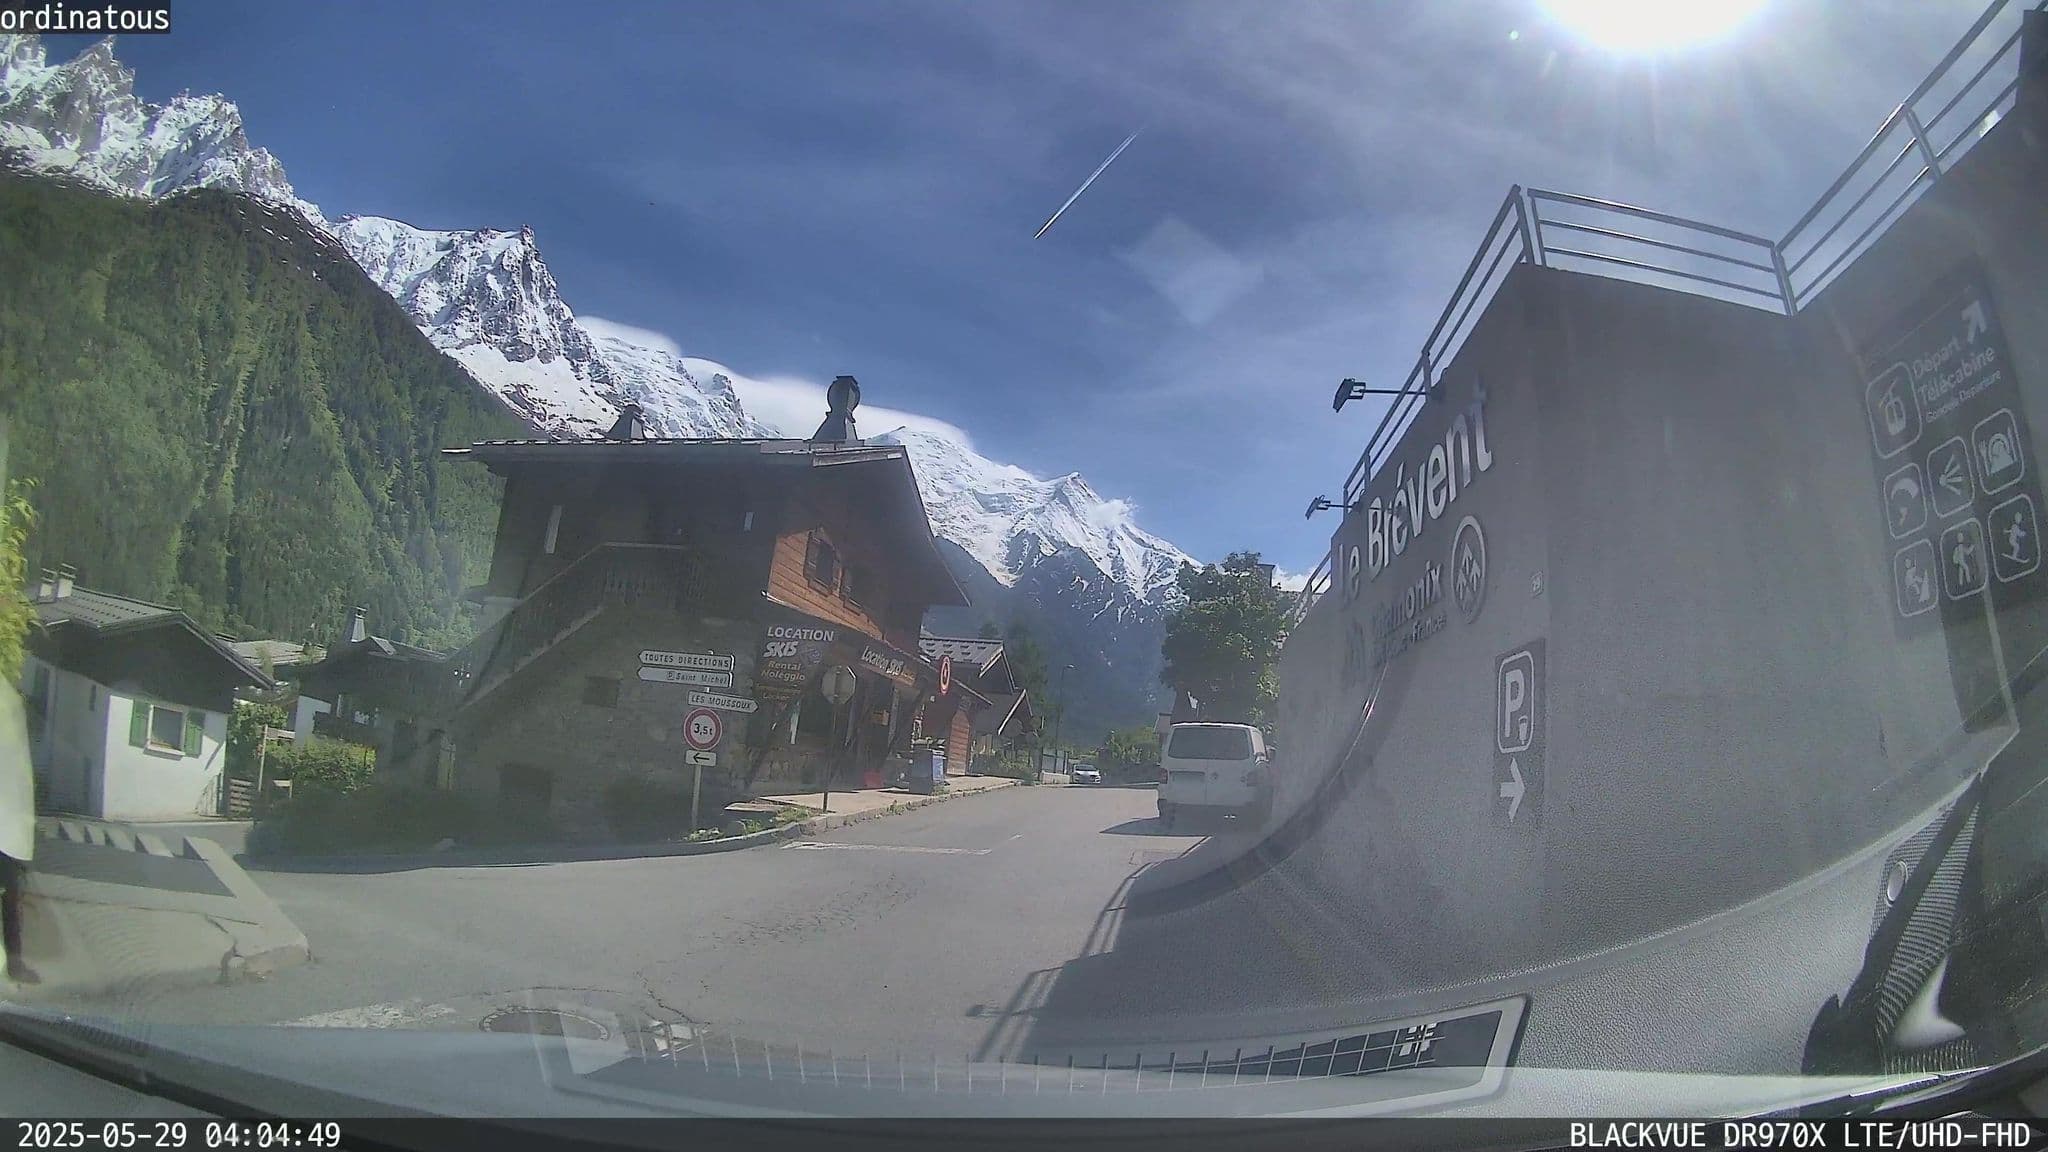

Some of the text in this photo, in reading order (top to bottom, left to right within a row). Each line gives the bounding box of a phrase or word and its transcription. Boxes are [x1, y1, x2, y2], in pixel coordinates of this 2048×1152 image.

[1918, 346, 1995, 405] Télécabine
[1368, 372, 1493, 582] Brévent
[767, 626, 835, 642] LOCATION
[762, 641, 799, 658] SKIS
[861, 645, 887, 670] Location
[644, 653, 729, 668] TOUTES DIRECTIONS
[768, 660, 803, 671] Rental
[675, 672, 696, 682] Saint
[701, 674, 728, 685] Michel
[759, 670, 806, 682] Noleggio
[691, 694, 751, 709] LES MOUSSOUX
[1505, 668, 1525, 738] P
